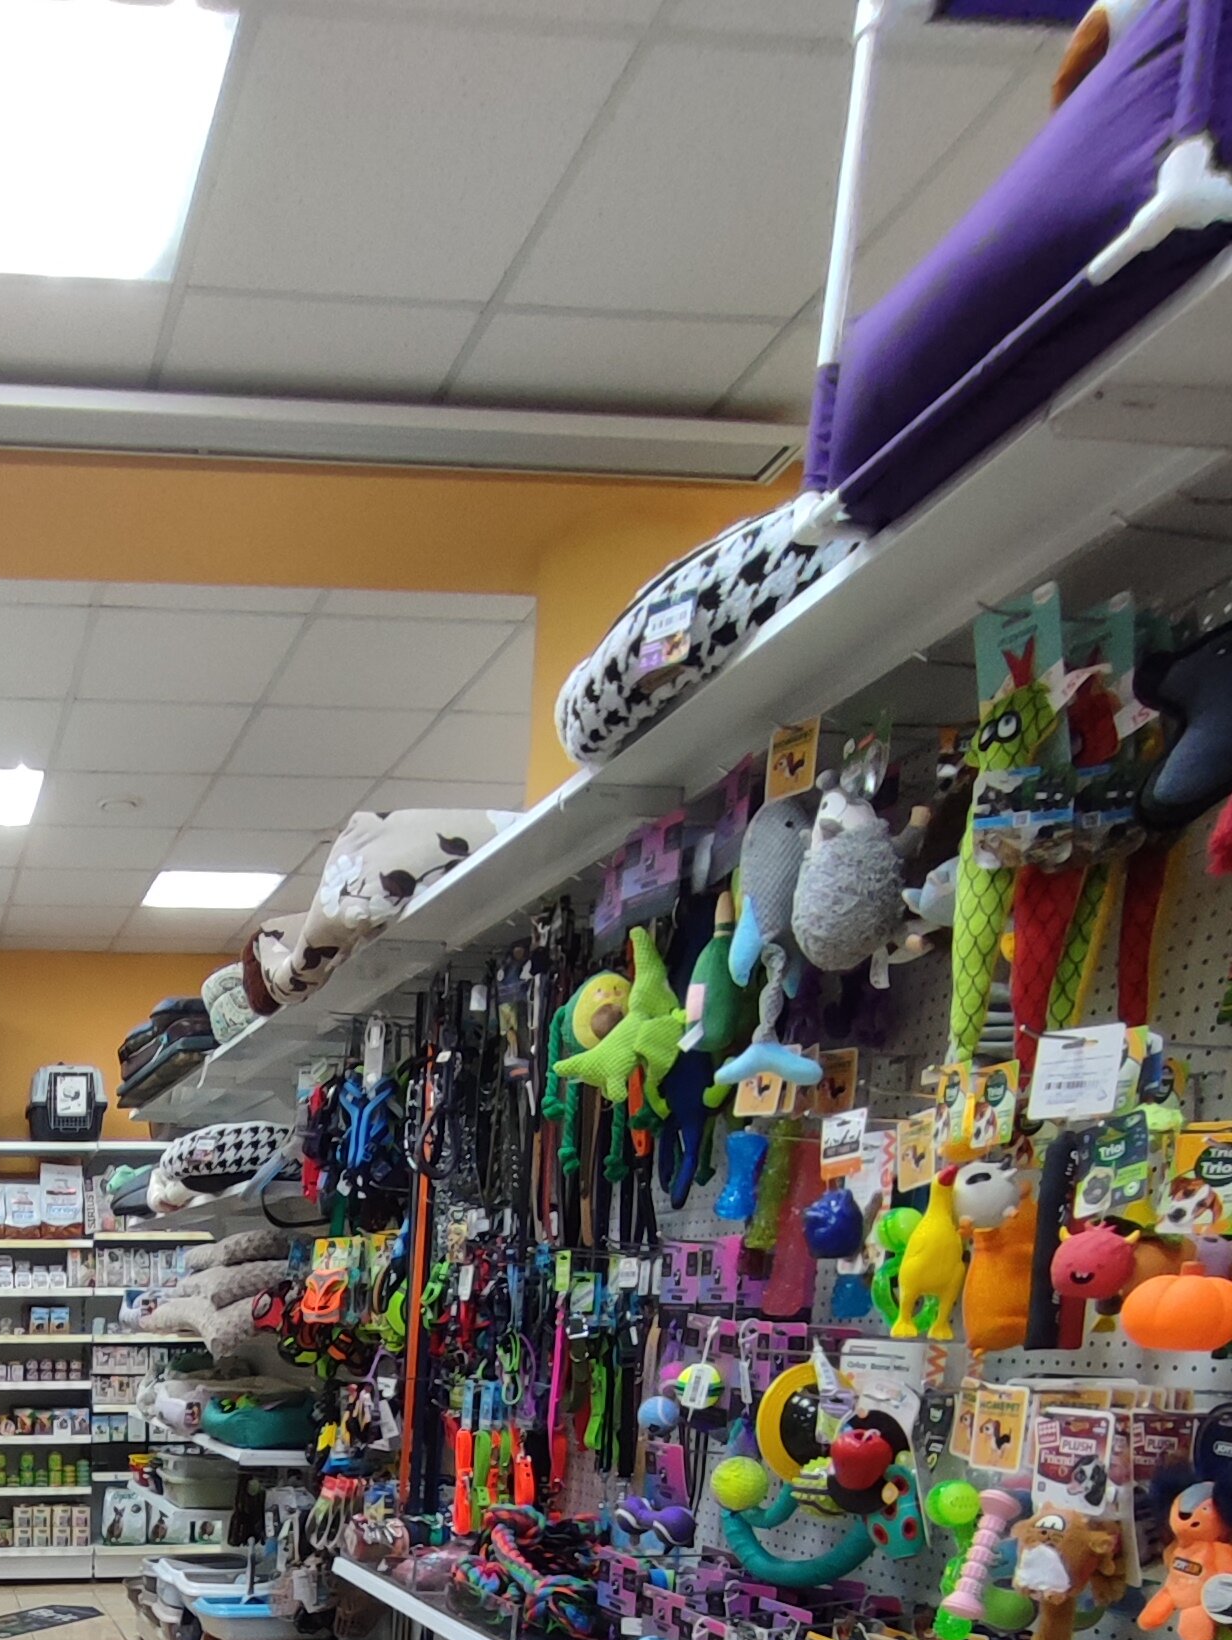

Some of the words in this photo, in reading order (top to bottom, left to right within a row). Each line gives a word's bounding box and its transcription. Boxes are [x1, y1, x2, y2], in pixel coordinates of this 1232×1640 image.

[1098, 1140, 1126, 1159] Triol
[1201, 1161, 1232, 1175] Trio
[1062, 1438, 1094, 1452] PLUSH
